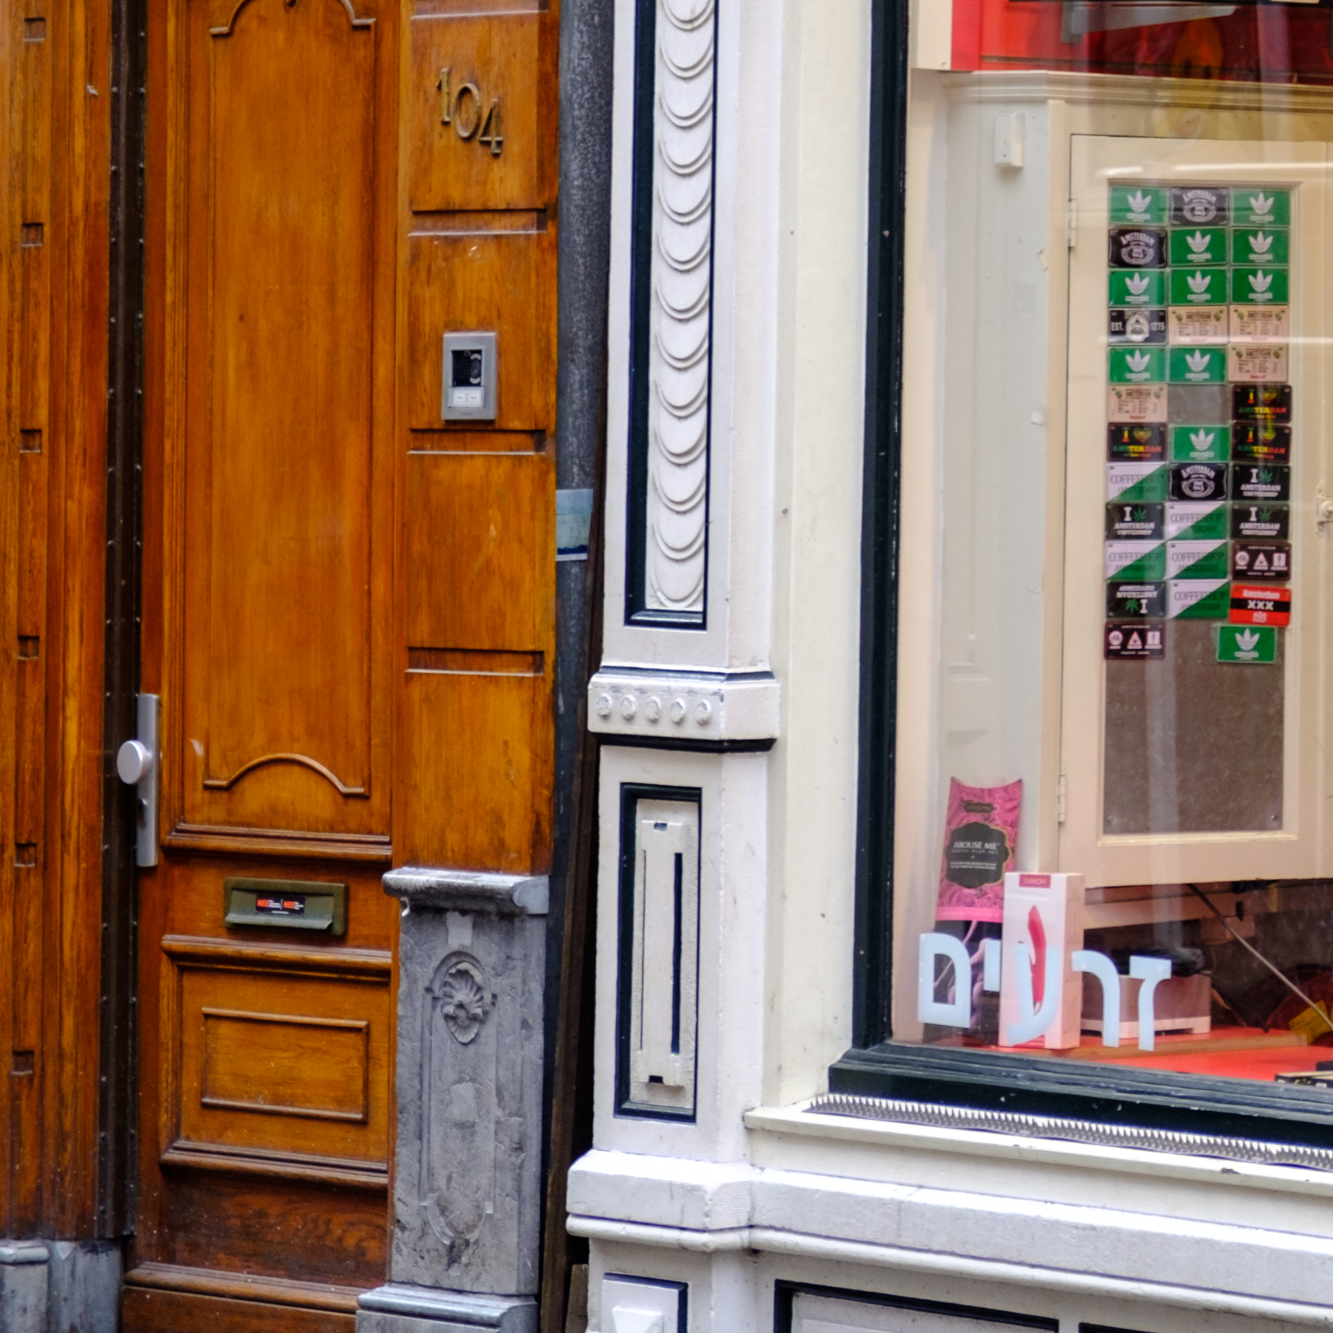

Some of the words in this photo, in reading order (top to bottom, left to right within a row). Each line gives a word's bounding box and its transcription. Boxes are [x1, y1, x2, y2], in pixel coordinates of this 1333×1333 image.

[436, 67, 504, 157] 104
[1247, 600, 1274, 610] XXX
[953, 841, 982, 849] AROUSE
[918, 933, 1172, 1052] זרעים
